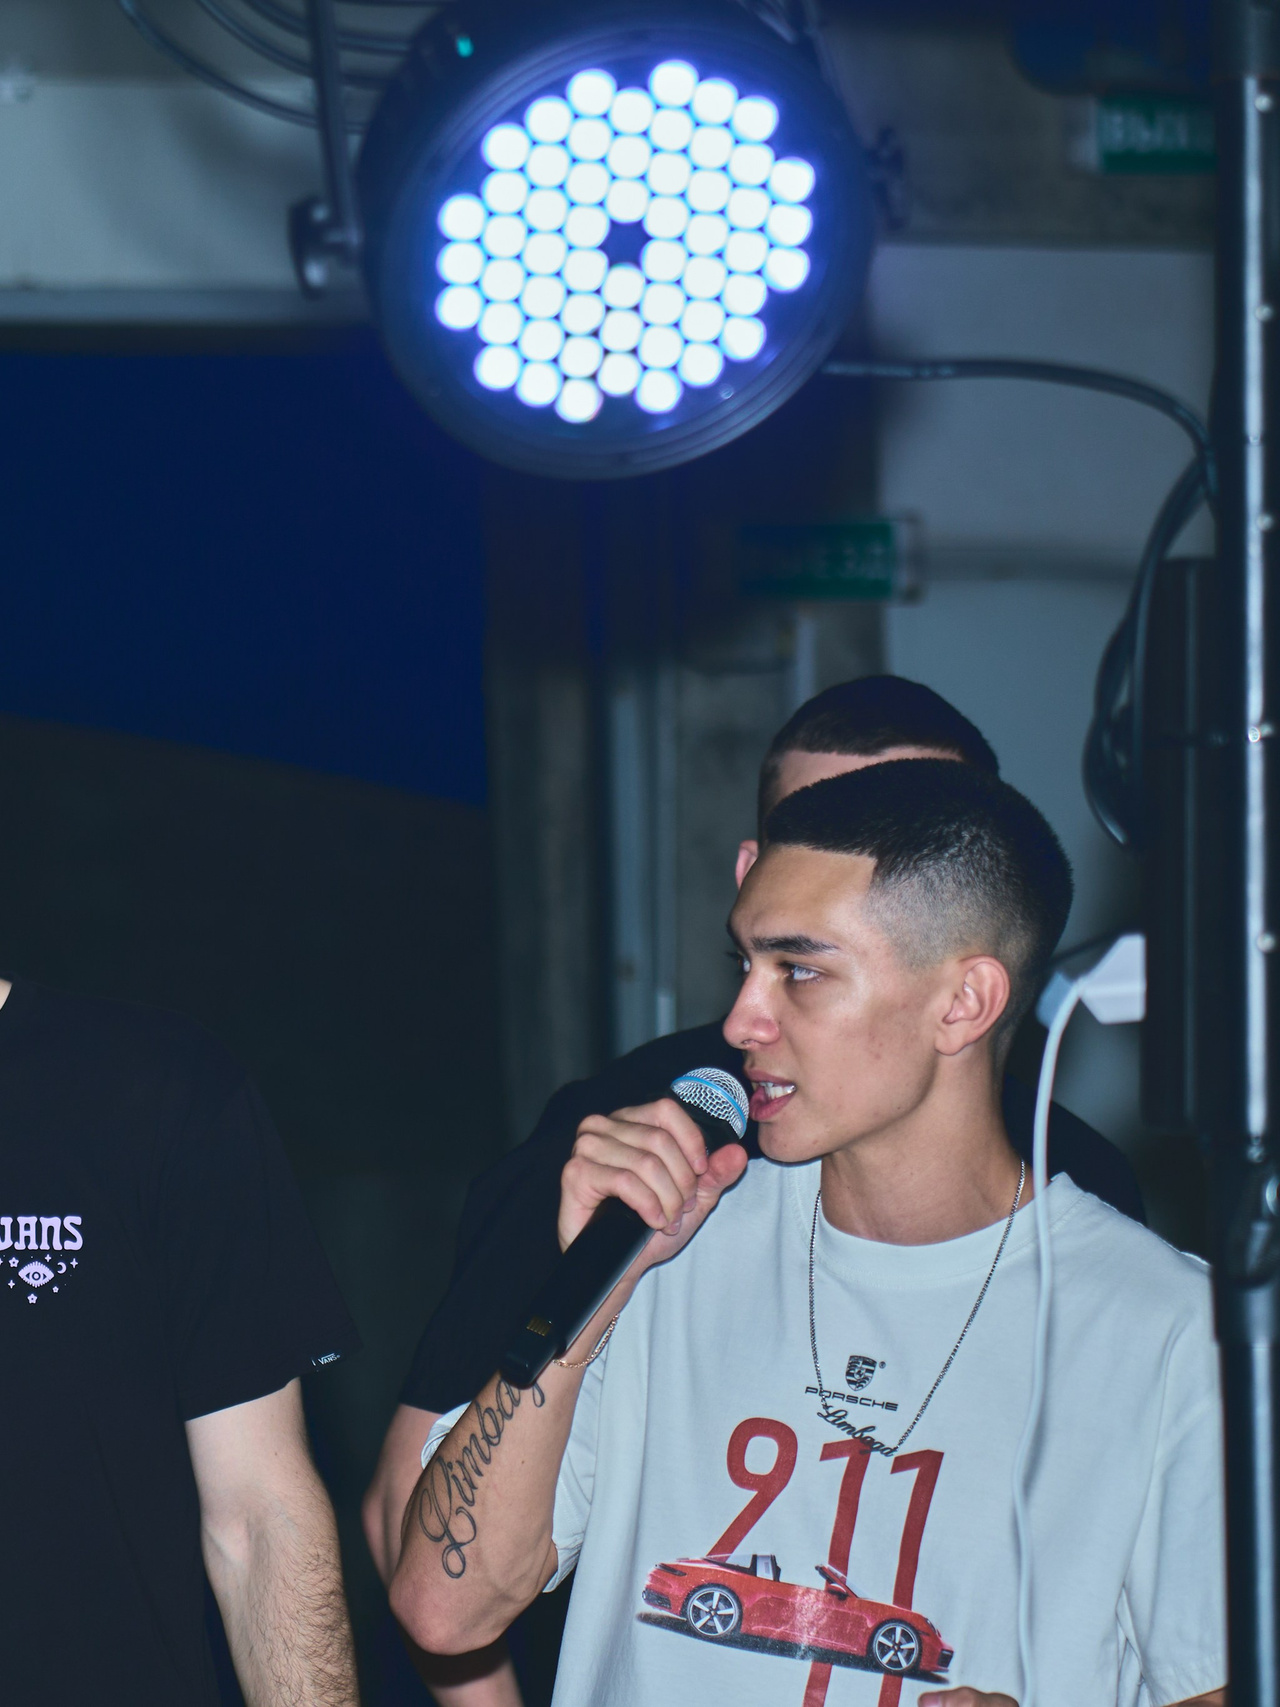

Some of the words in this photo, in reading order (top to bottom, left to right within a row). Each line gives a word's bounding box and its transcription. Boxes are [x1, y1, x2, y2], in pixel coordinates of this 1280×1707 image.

[318, 1353, 338, 1365] VANS
[804, 1386, 899, 1412] PORSCHE
[704, 1416, 945, 1612] 911
